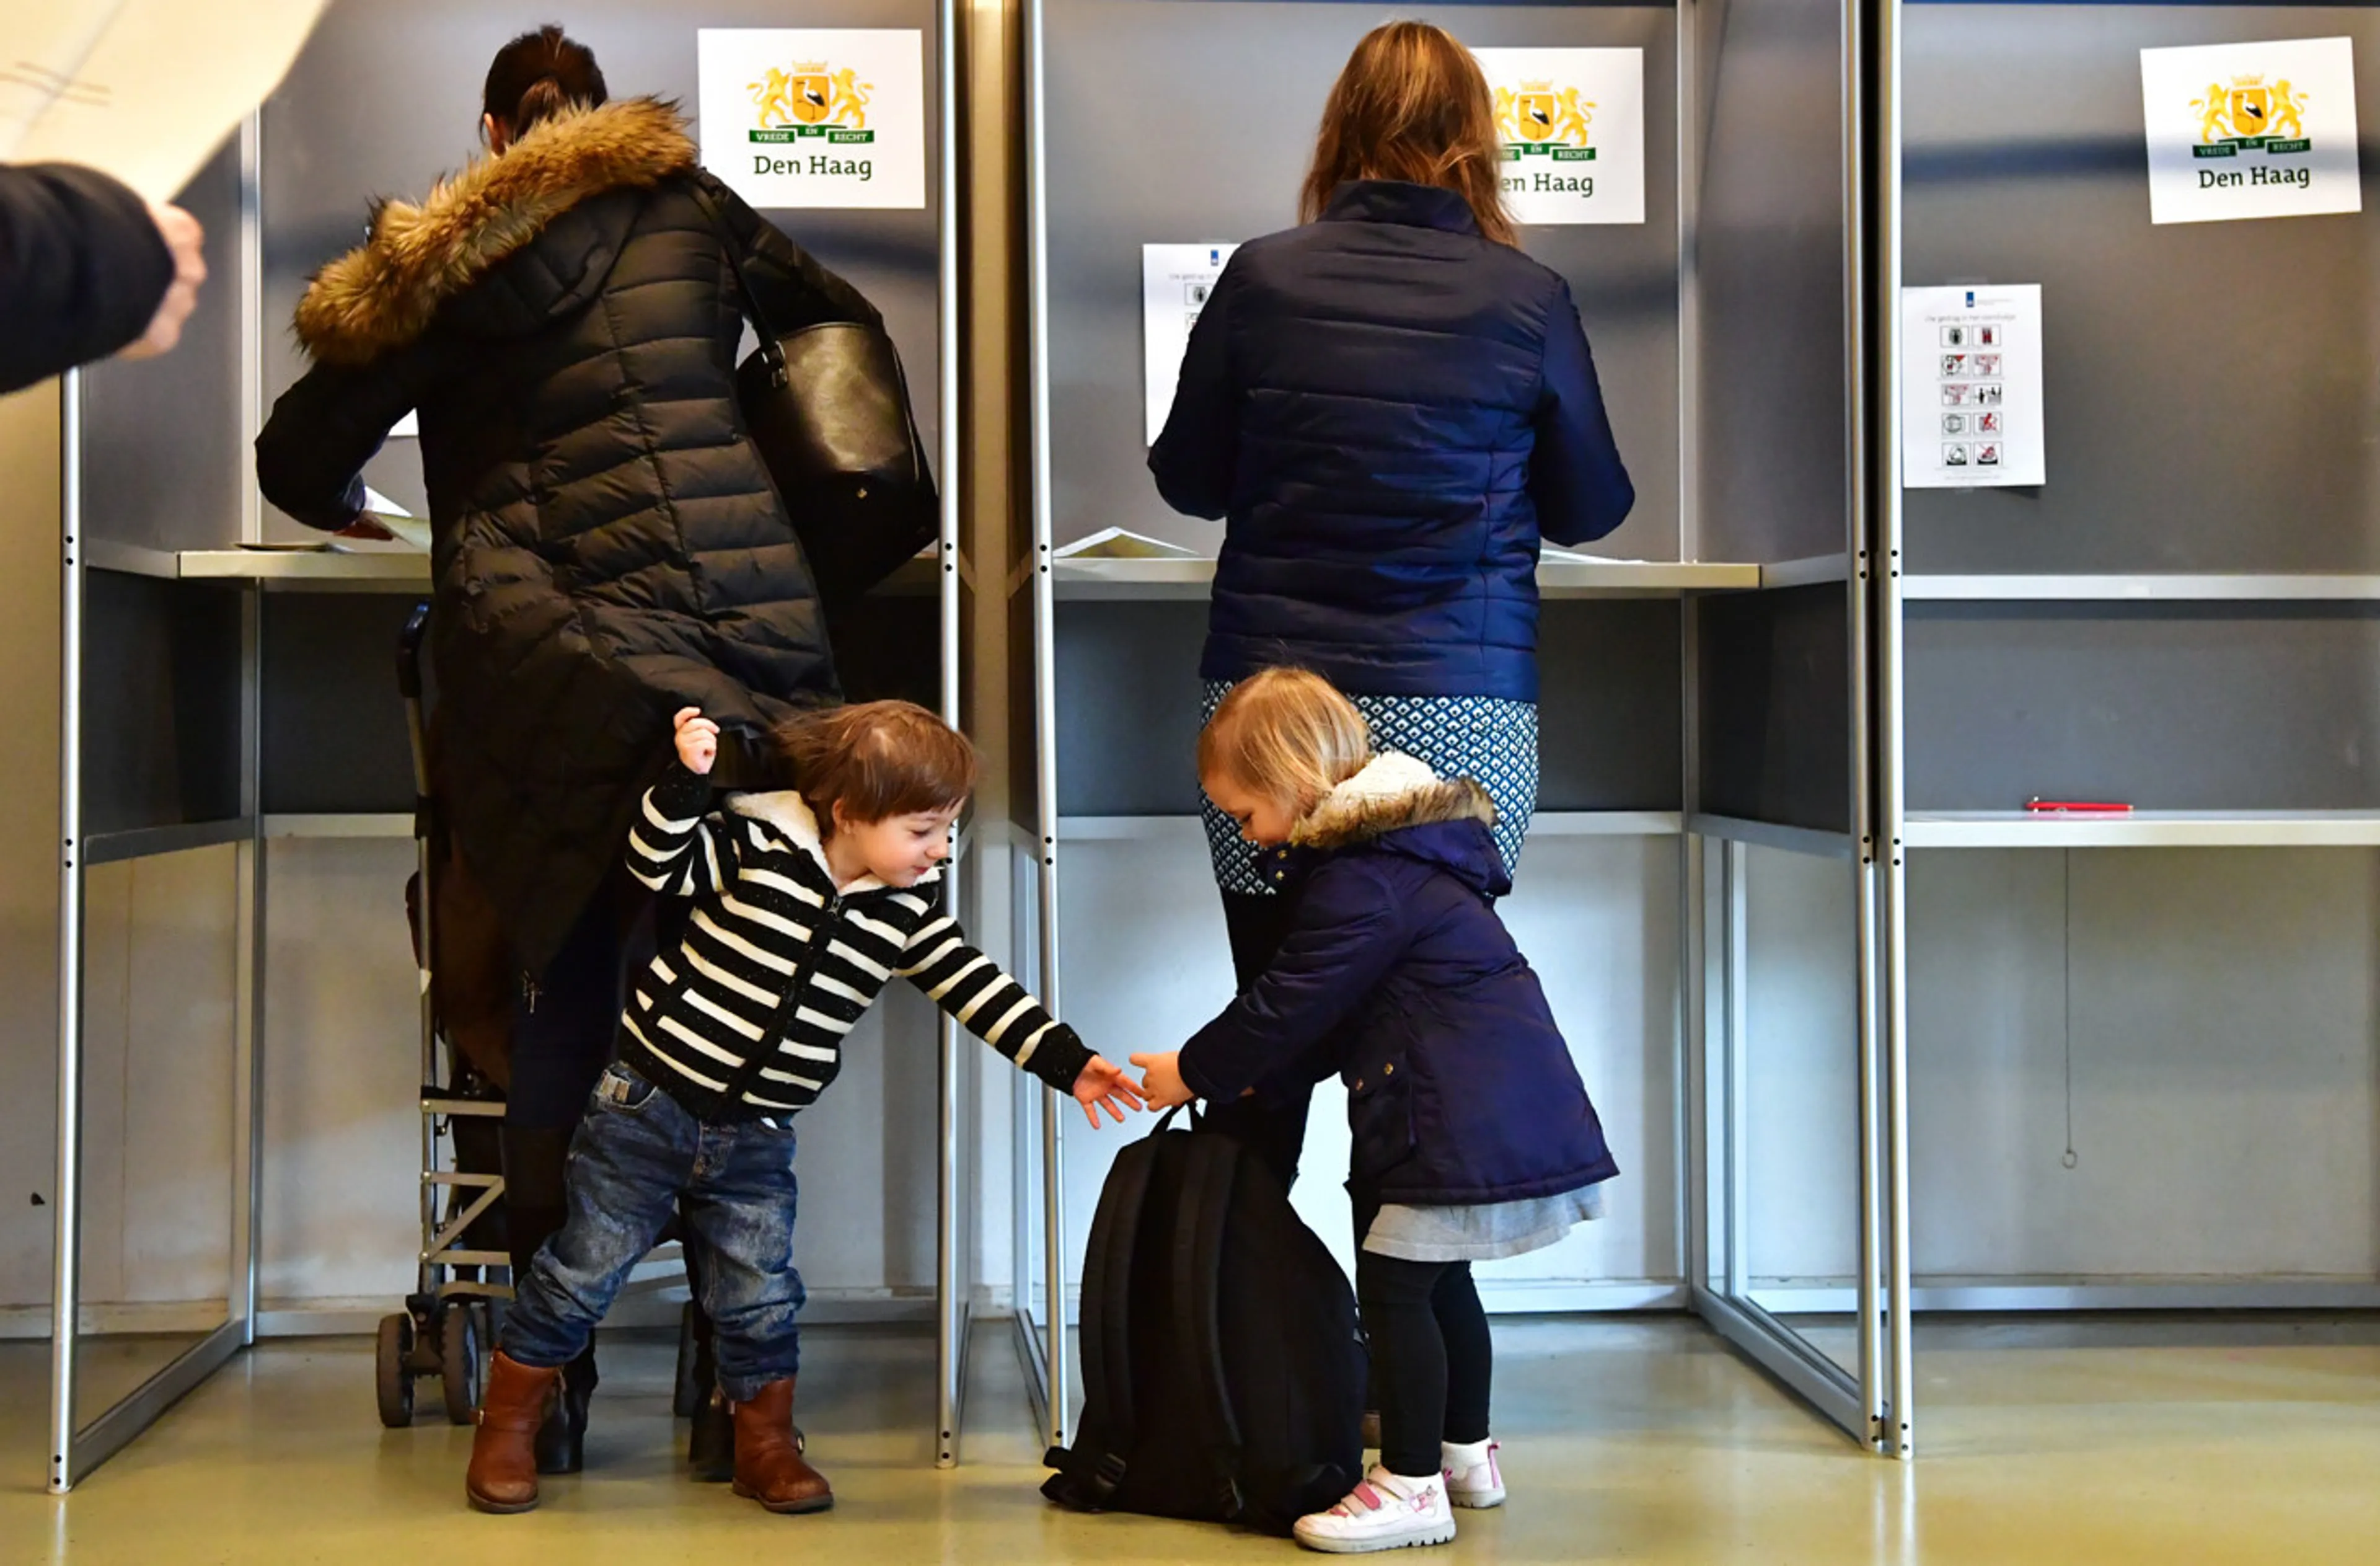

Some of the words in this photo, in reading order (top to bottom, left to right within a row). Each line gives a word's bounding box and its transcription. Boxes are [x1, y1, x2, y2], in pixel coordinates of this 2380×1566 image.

[756, 133, 789, 141] VREDE
[834, 133, 868, 141] RECHT
[754, 156, 801, 174] Den
[808, 156, 872, 181] Haag
[2198, 169, 2244, 188] Den
[2250, 166, 2311, 189] Haag
[1500, 176, 1526, 192] en
[1533, 173, 1593, 198] Haag
